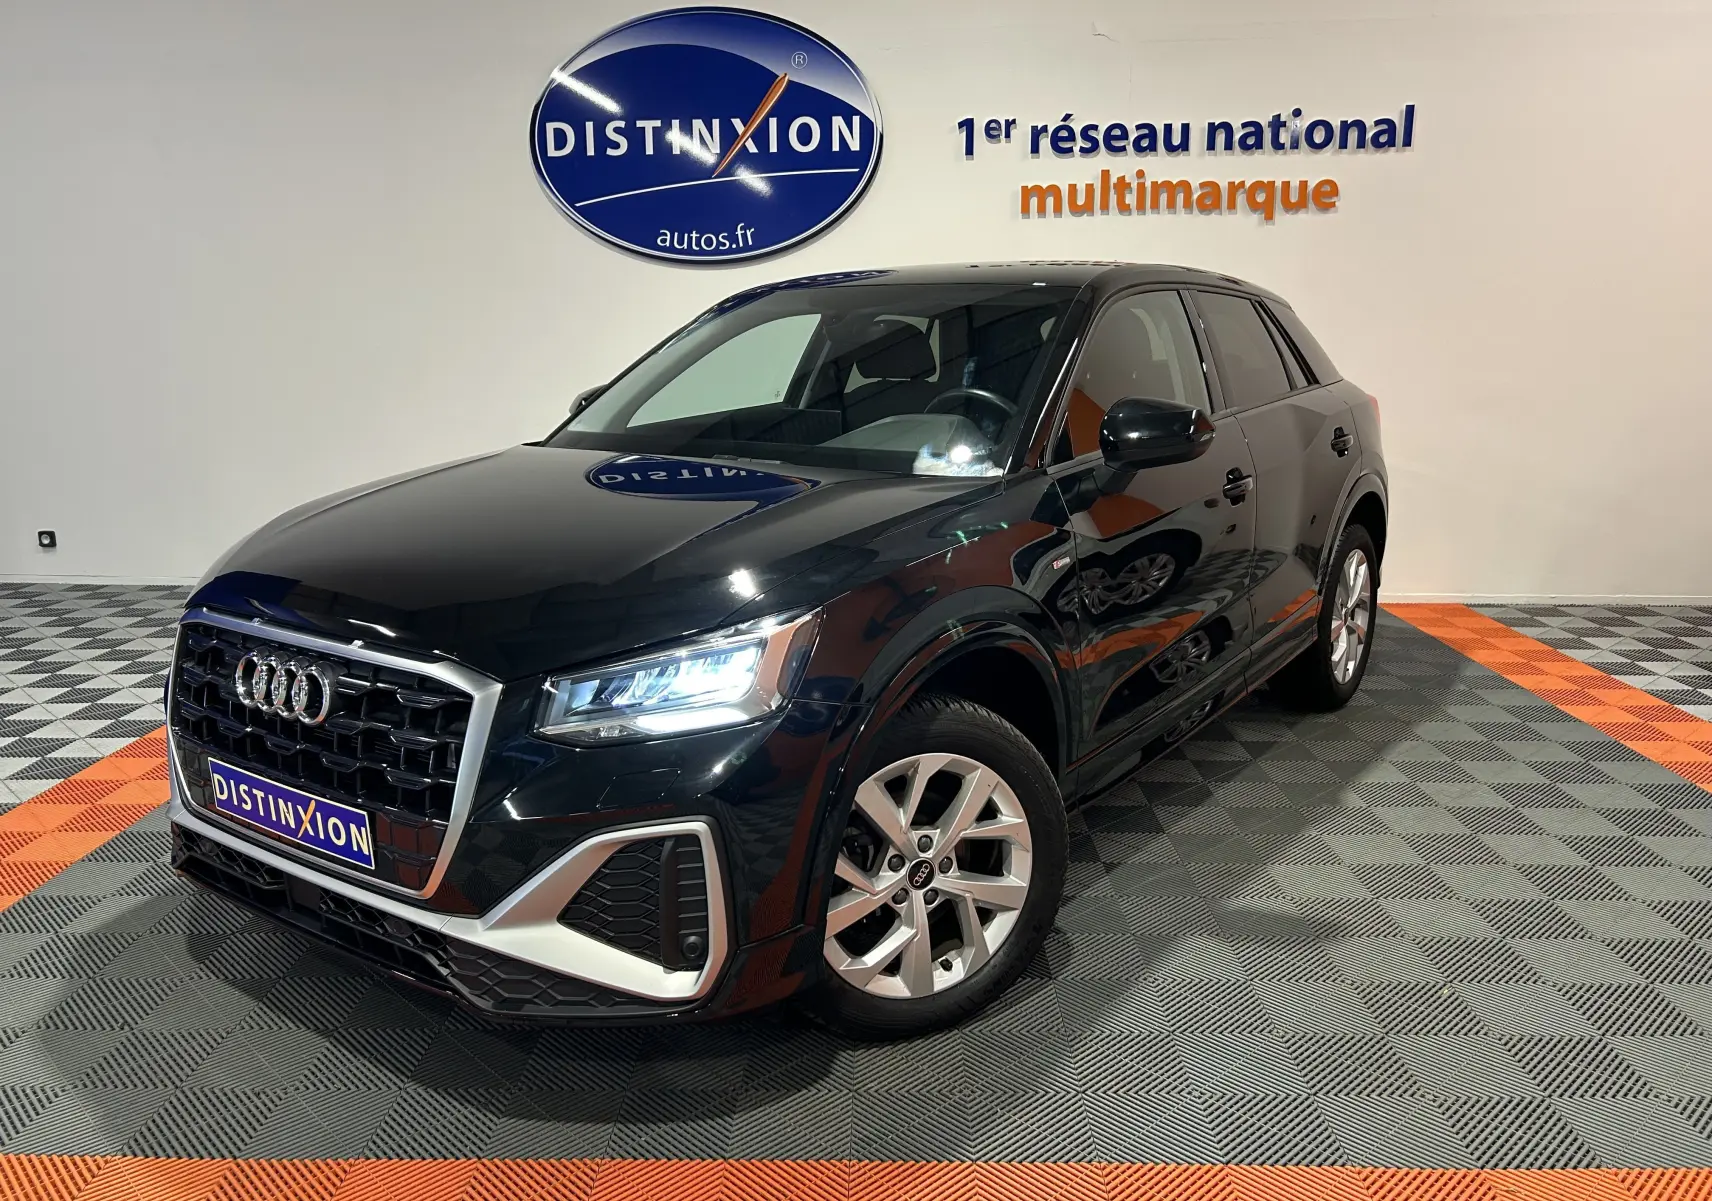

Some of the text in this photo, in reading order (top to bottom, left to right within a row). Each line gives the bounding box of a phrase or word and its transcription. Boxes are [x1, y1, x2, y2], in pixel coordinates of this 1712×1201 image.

[957, 104, 1416, 156] 1er réseau national
[1020, 168, 1340, 221] multimarque
[656, 222, 756, 252] autos.fr
[212, 772, 370, 856] DISTINXION
